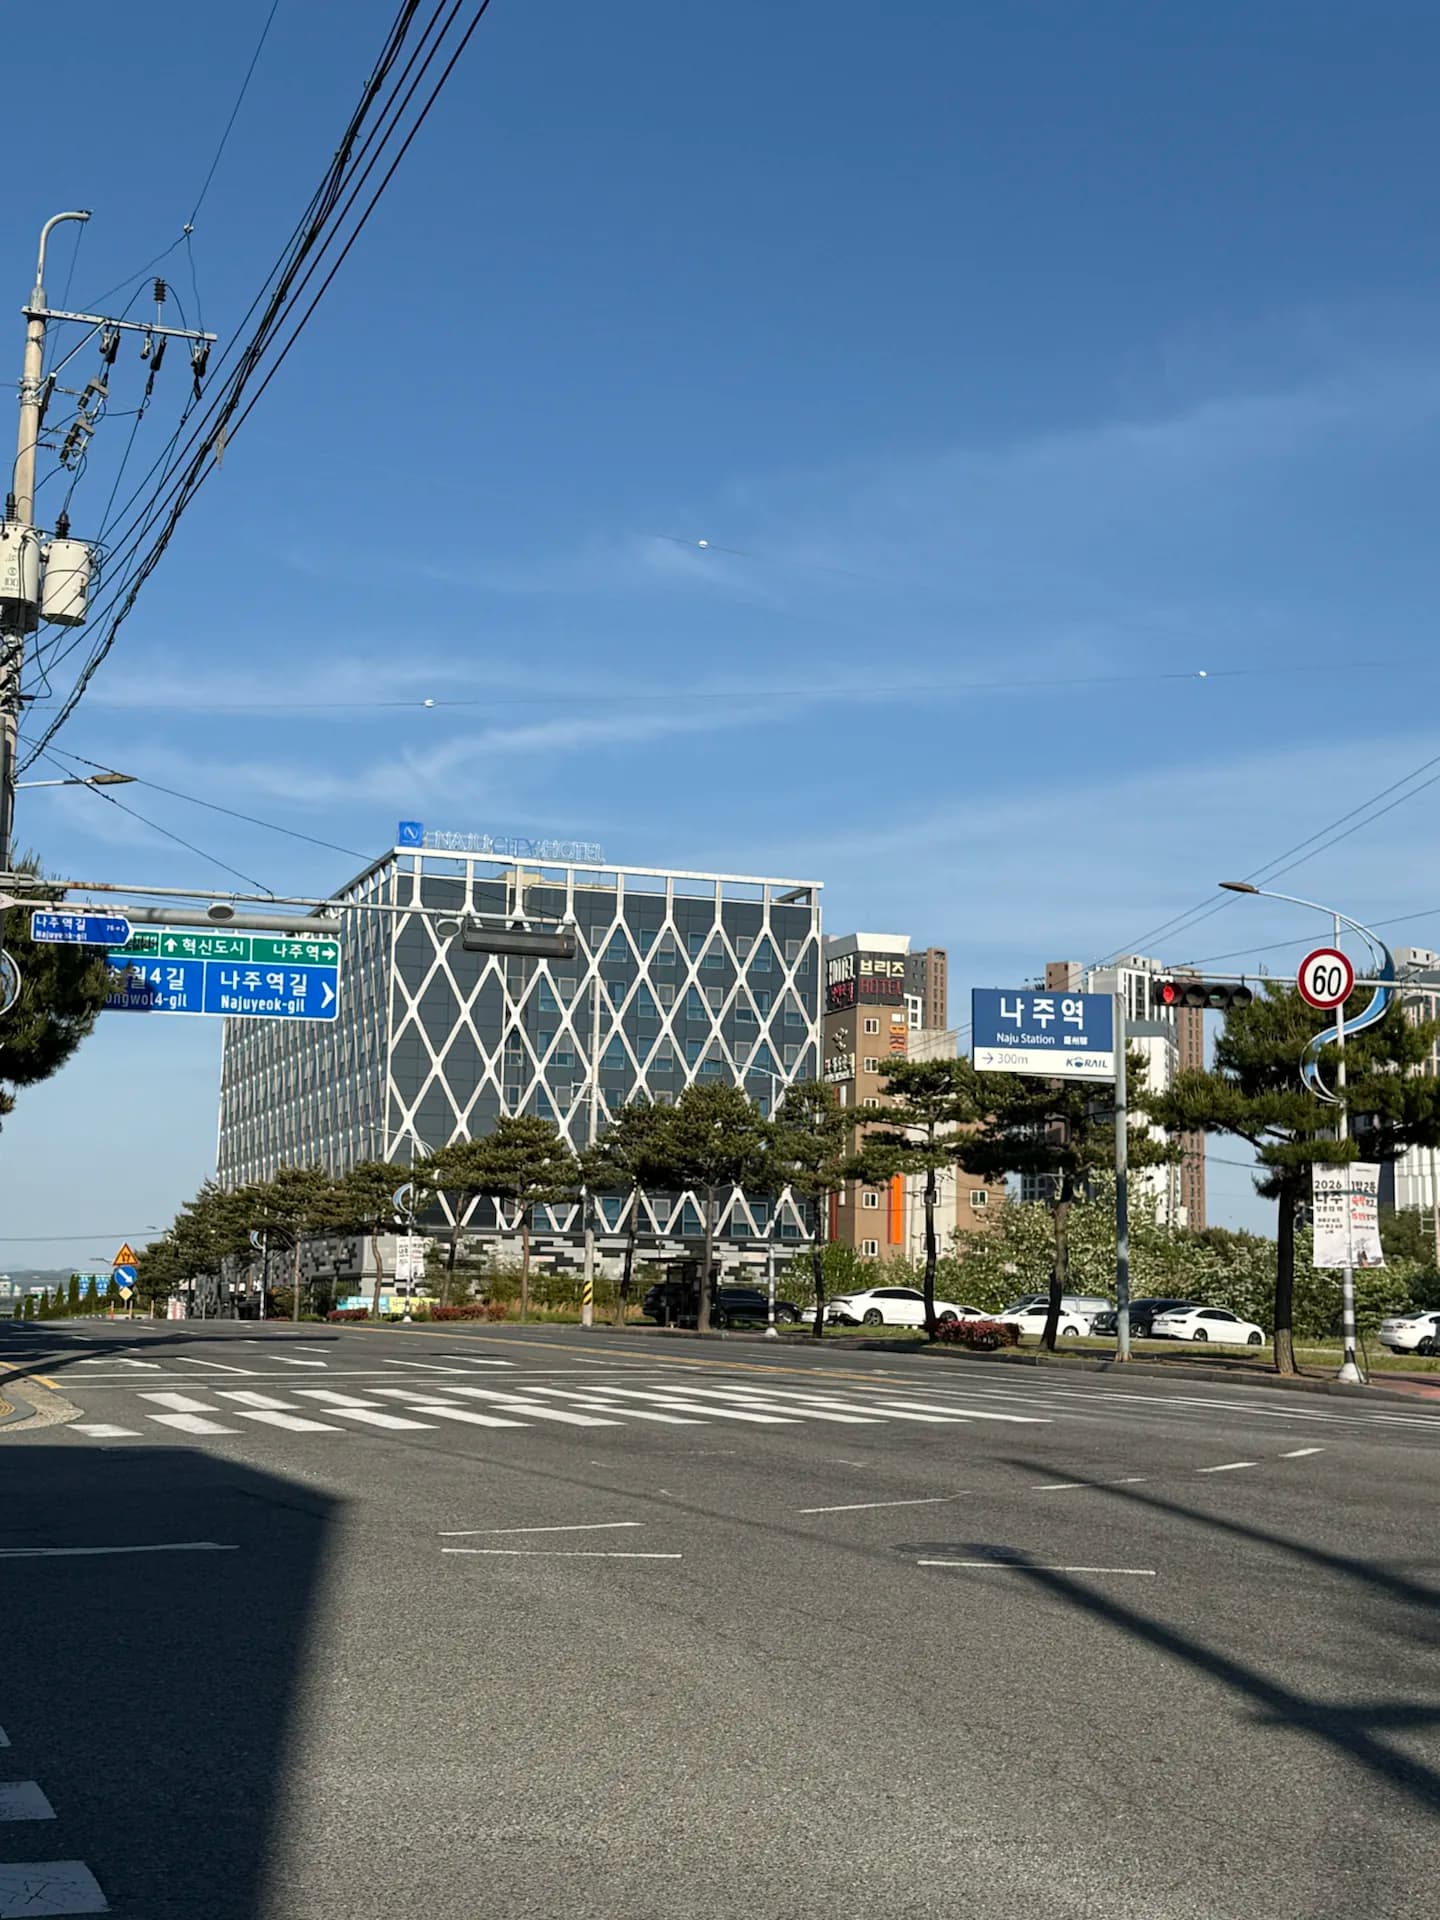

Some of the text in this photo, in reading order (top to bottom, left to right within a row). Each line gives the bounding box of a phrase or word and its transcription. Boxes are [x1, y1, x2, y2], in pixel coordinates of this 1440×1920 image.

[36, 917, 86, 931] 나주역길
[182, 938, 244, 956] 혁신도시
[273, 943, 319, 962] 나주역
[859, 960, 904, 978] 브리즈
[220, 970, 307, 997] 나주역길
[860, 978, 902, 994] HOTEL
[1313, 965, 1341, 996] 60
[221, 994, 305, 1014] Najuyeok-gil
[1000, 997, 1083, 1030] 나주역
[996, 1032, 1019, 1045] Naju
[1020, 1034, 1055, 1045] Station
[997, 1053, 1028, 1065] 300m
[1065, 1057, 1108, 1068] KORAIL
[1314, 1180, 1342, 1190] 2026
[1315, 1191, 1343, 1205] 나주
